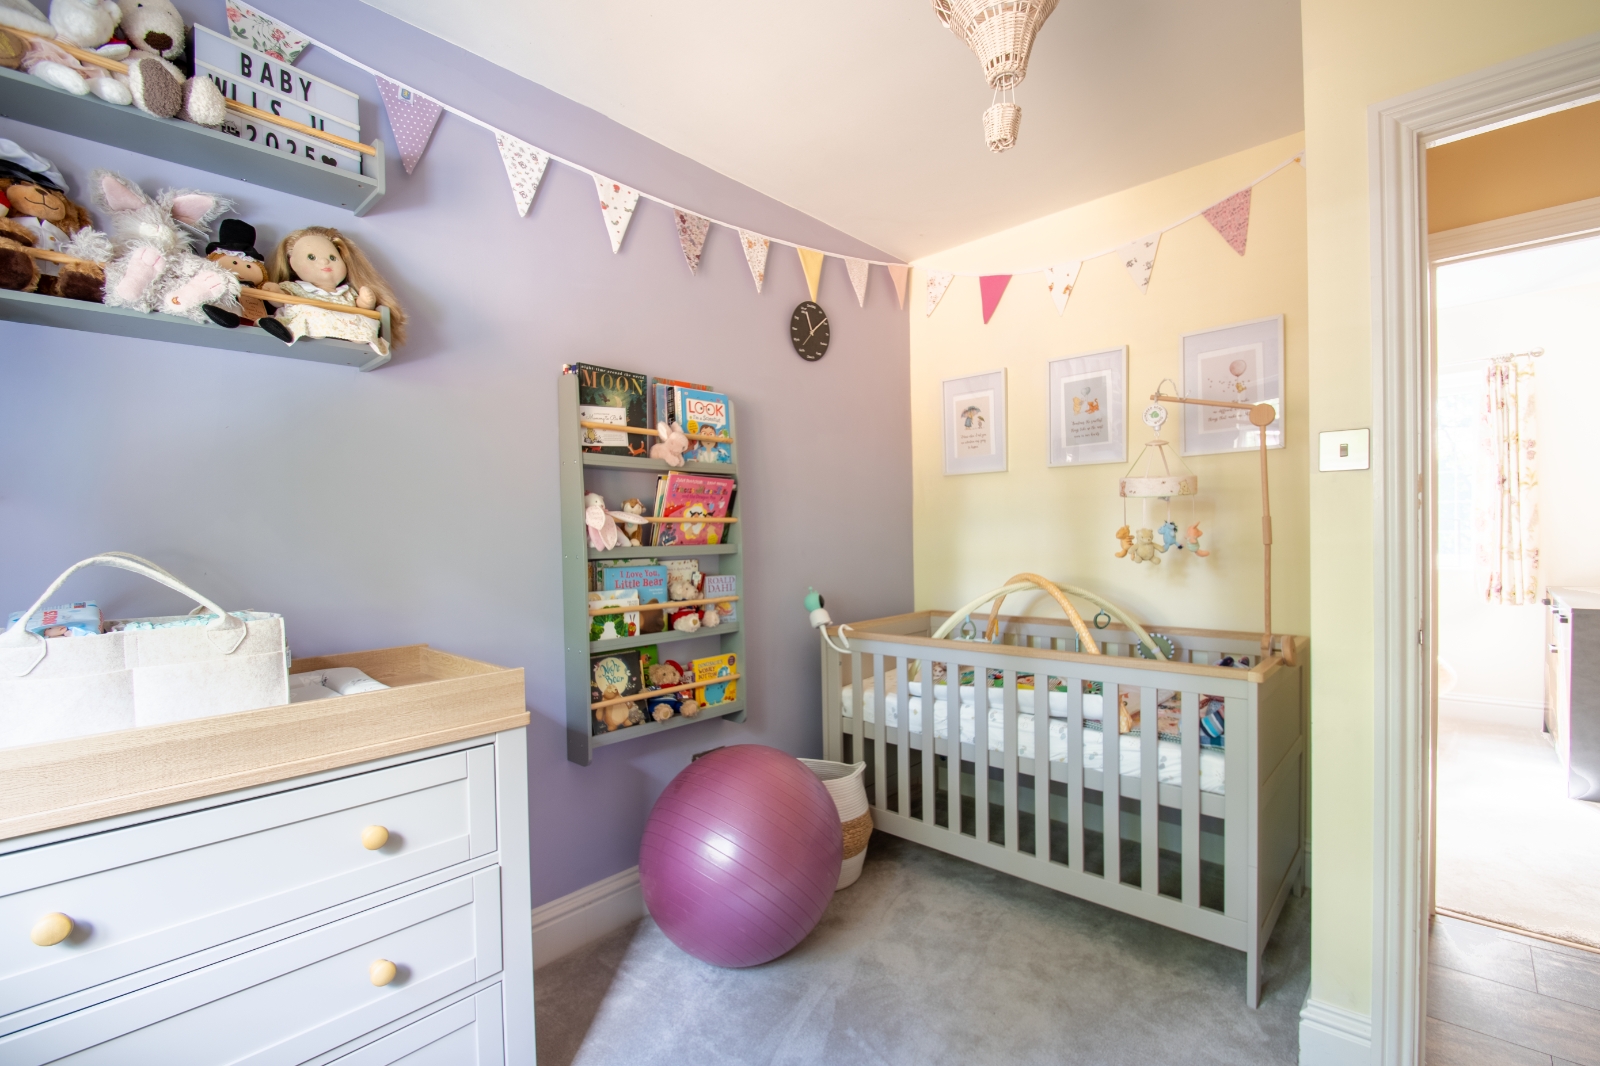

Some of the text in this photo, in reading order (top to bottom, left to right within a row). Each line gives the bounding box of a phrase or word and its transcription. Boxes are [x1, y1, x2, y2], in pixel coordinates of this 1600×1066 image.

[240, 51, 312, 102] BABY
[246, 124, 315, 161] 2025
[581, 369, 644, 396] MOON
[688, 400, 724, 417] LOOK
[626, 571, 643, 579] Love
[707, 576, 735, 585] ROALD
[614, 578, 664, 589] Little Bear
[707, 583, 735, 593] DAHL
[602, 674, 624, 684] Bear
